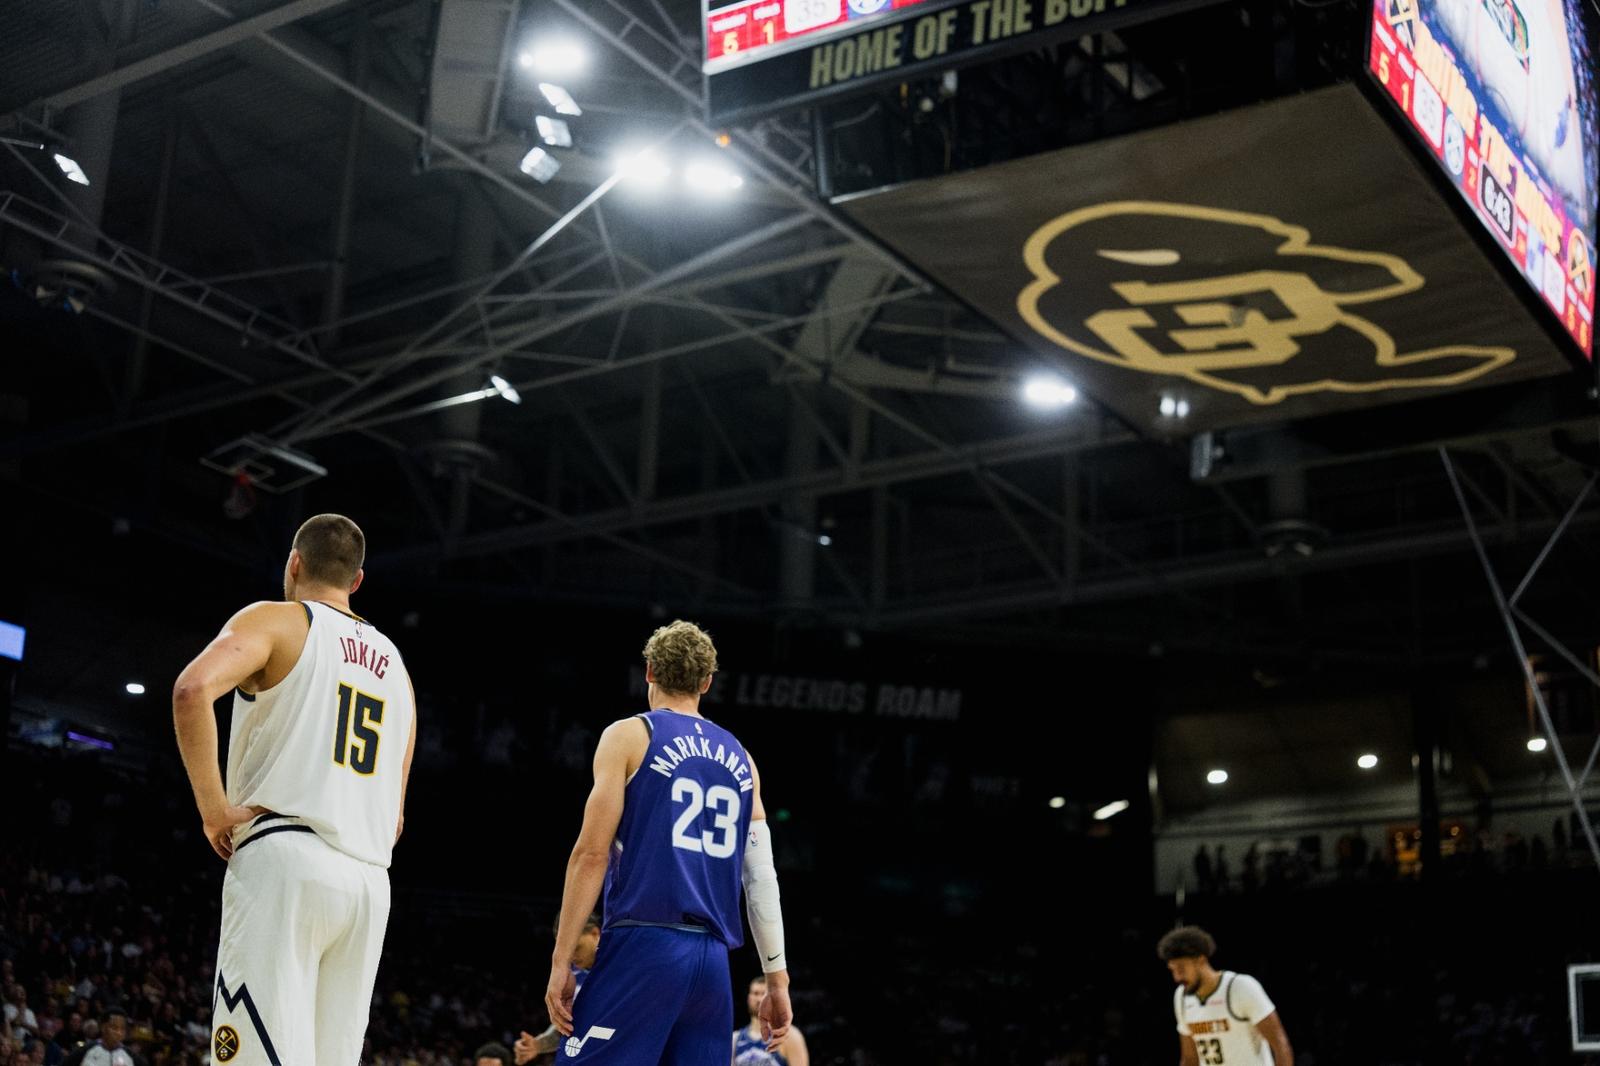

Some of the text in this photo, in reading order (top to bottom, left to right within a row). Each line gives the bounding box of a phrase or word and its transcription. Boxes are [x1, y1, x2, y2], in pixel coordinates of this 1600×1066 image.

[762, 20, 774, 45] 1
[809, 23, 903, 88] HOME
[911, 10, 959, 60] OF
[970, 0, 1032, 46] THE
[1379, 51, 1389, 84] 5
[1402, 82, 1409, 112] 1
[339, 636, 391, 680] JOKIĆ
[735, 673, 868, 714] LEGENDS
[875, 683, 963, 722] ROAM
[331, 680, 387, 778] 15
[649, 734, 754, 794] MARKKANEN
[671, 776, 741, 859] 23
